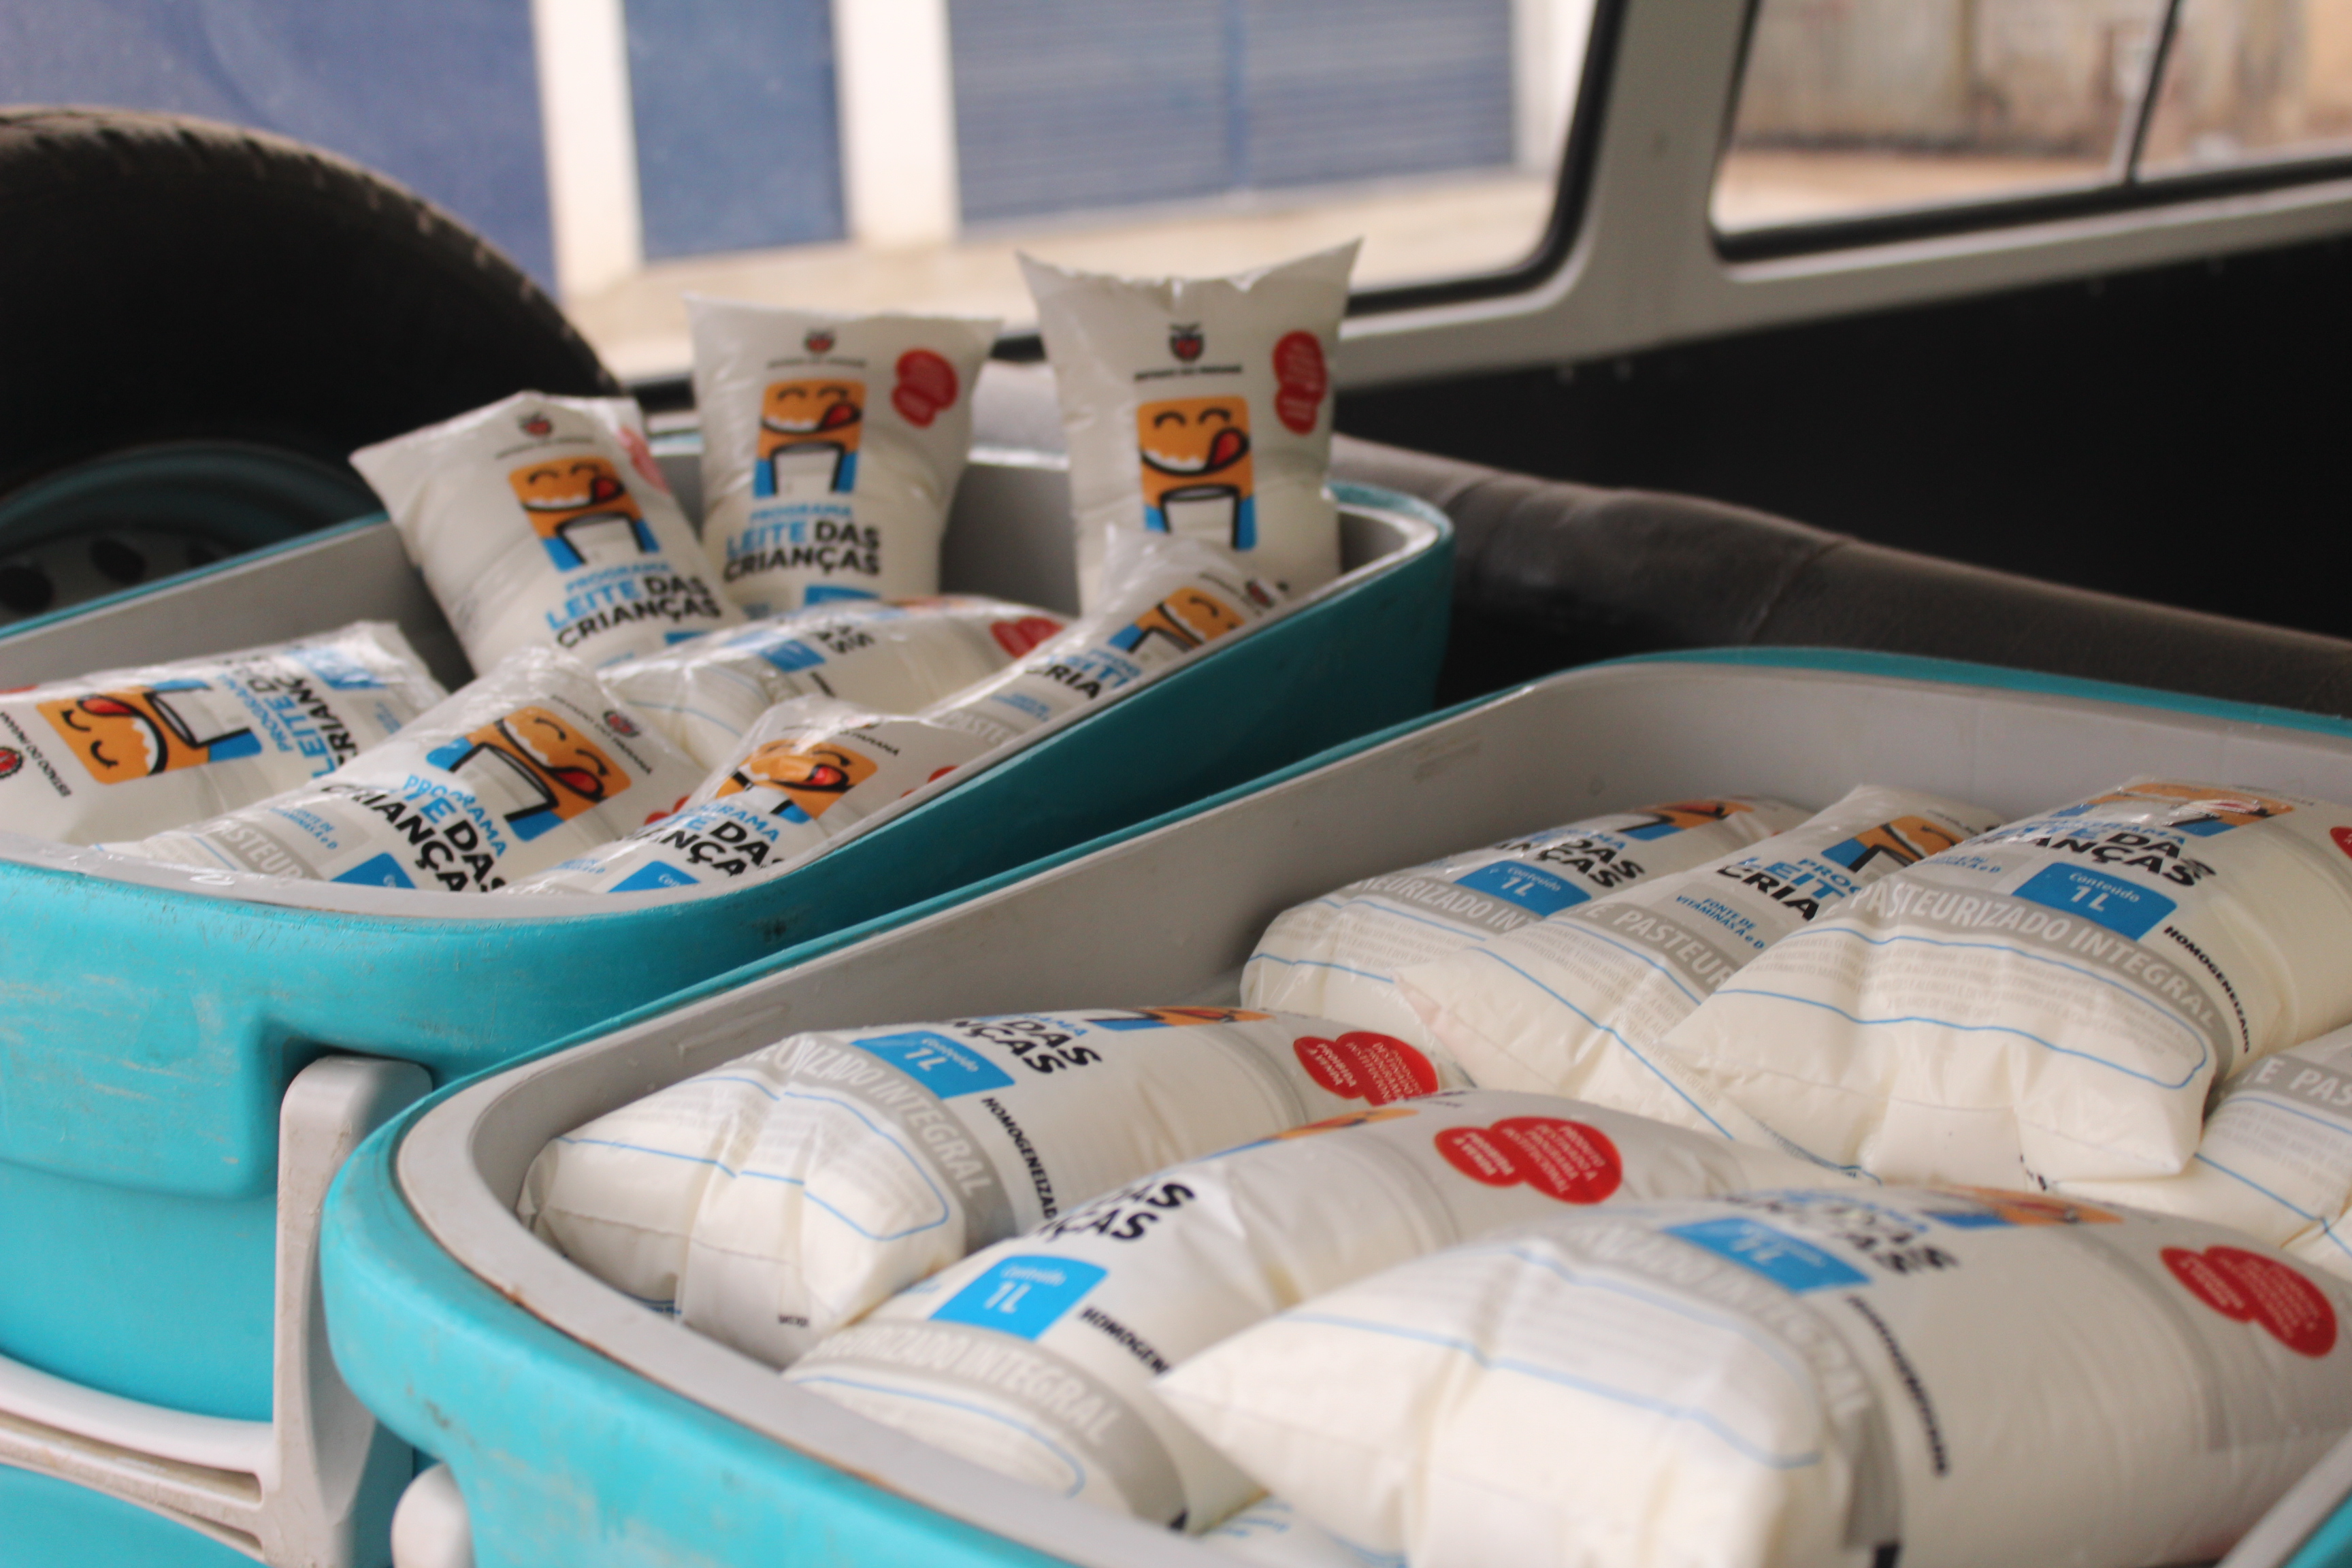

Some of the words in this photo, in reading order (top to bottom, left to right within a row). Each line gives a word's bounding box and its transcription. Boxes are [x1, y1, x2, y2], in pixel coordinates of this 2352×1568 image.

[815, 519, 880, 549] DAS
[723, 545, 881, 583] CRIANÇAS
[544, 579, 642, 630] LEITE
[642, 574, 711, 598] DAS
[555, 596, 722, 649] CRIANÇAS
[264, 696, 336, 779] LEITE
[1848, 881, 2072, 942] PASTEURIZADO
[2068, 926, 2215, 1026] INTEGRAL
[1002, 1020, 1103, 1066] DAS
[867, 1079, 992, 1197] INTEGRAL
